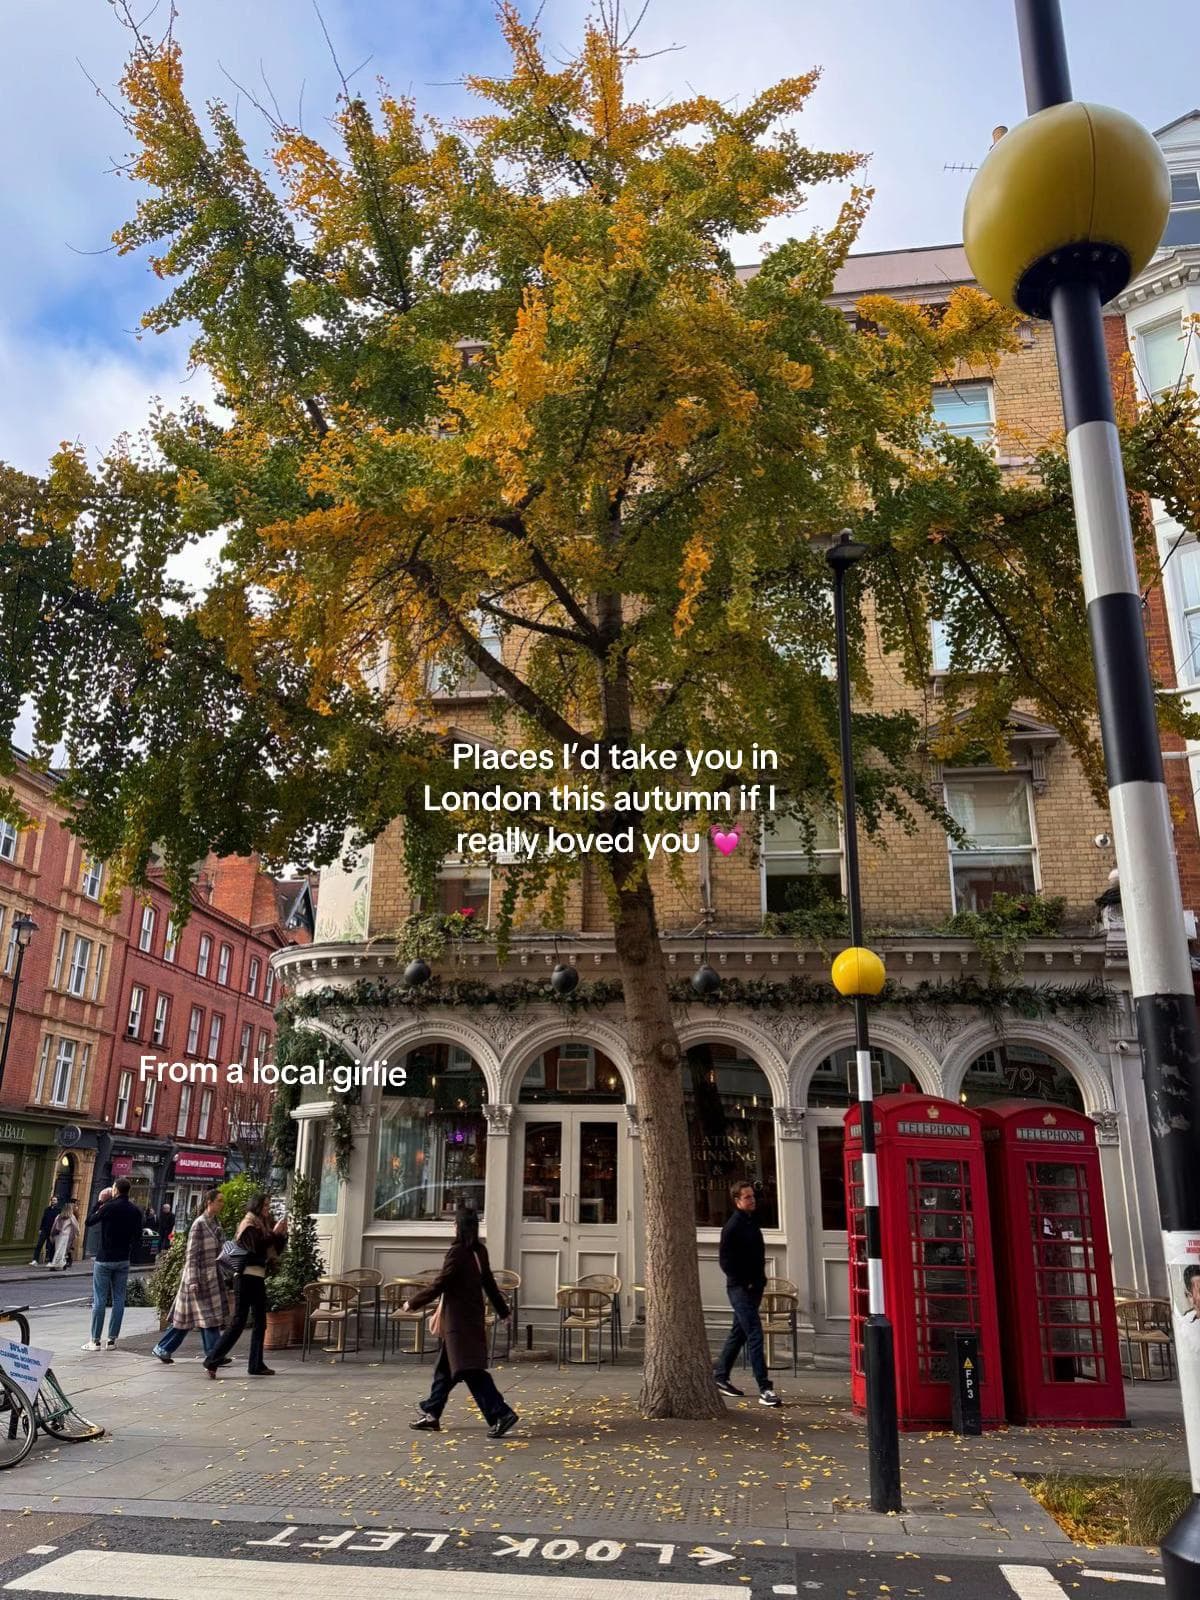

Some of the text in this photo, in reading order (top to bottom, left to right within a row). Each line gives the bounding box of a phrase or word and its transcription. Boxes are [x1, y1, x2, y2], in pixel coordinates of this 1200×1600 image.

[1004, 1067, 1035, 1091] 79
[901, 1123, 968, 1137] TELEPHONE
[1020, 1128, 1082, 1141] TELEPHONE
[246, 1526, 676, 1564] LOOK LEFT
